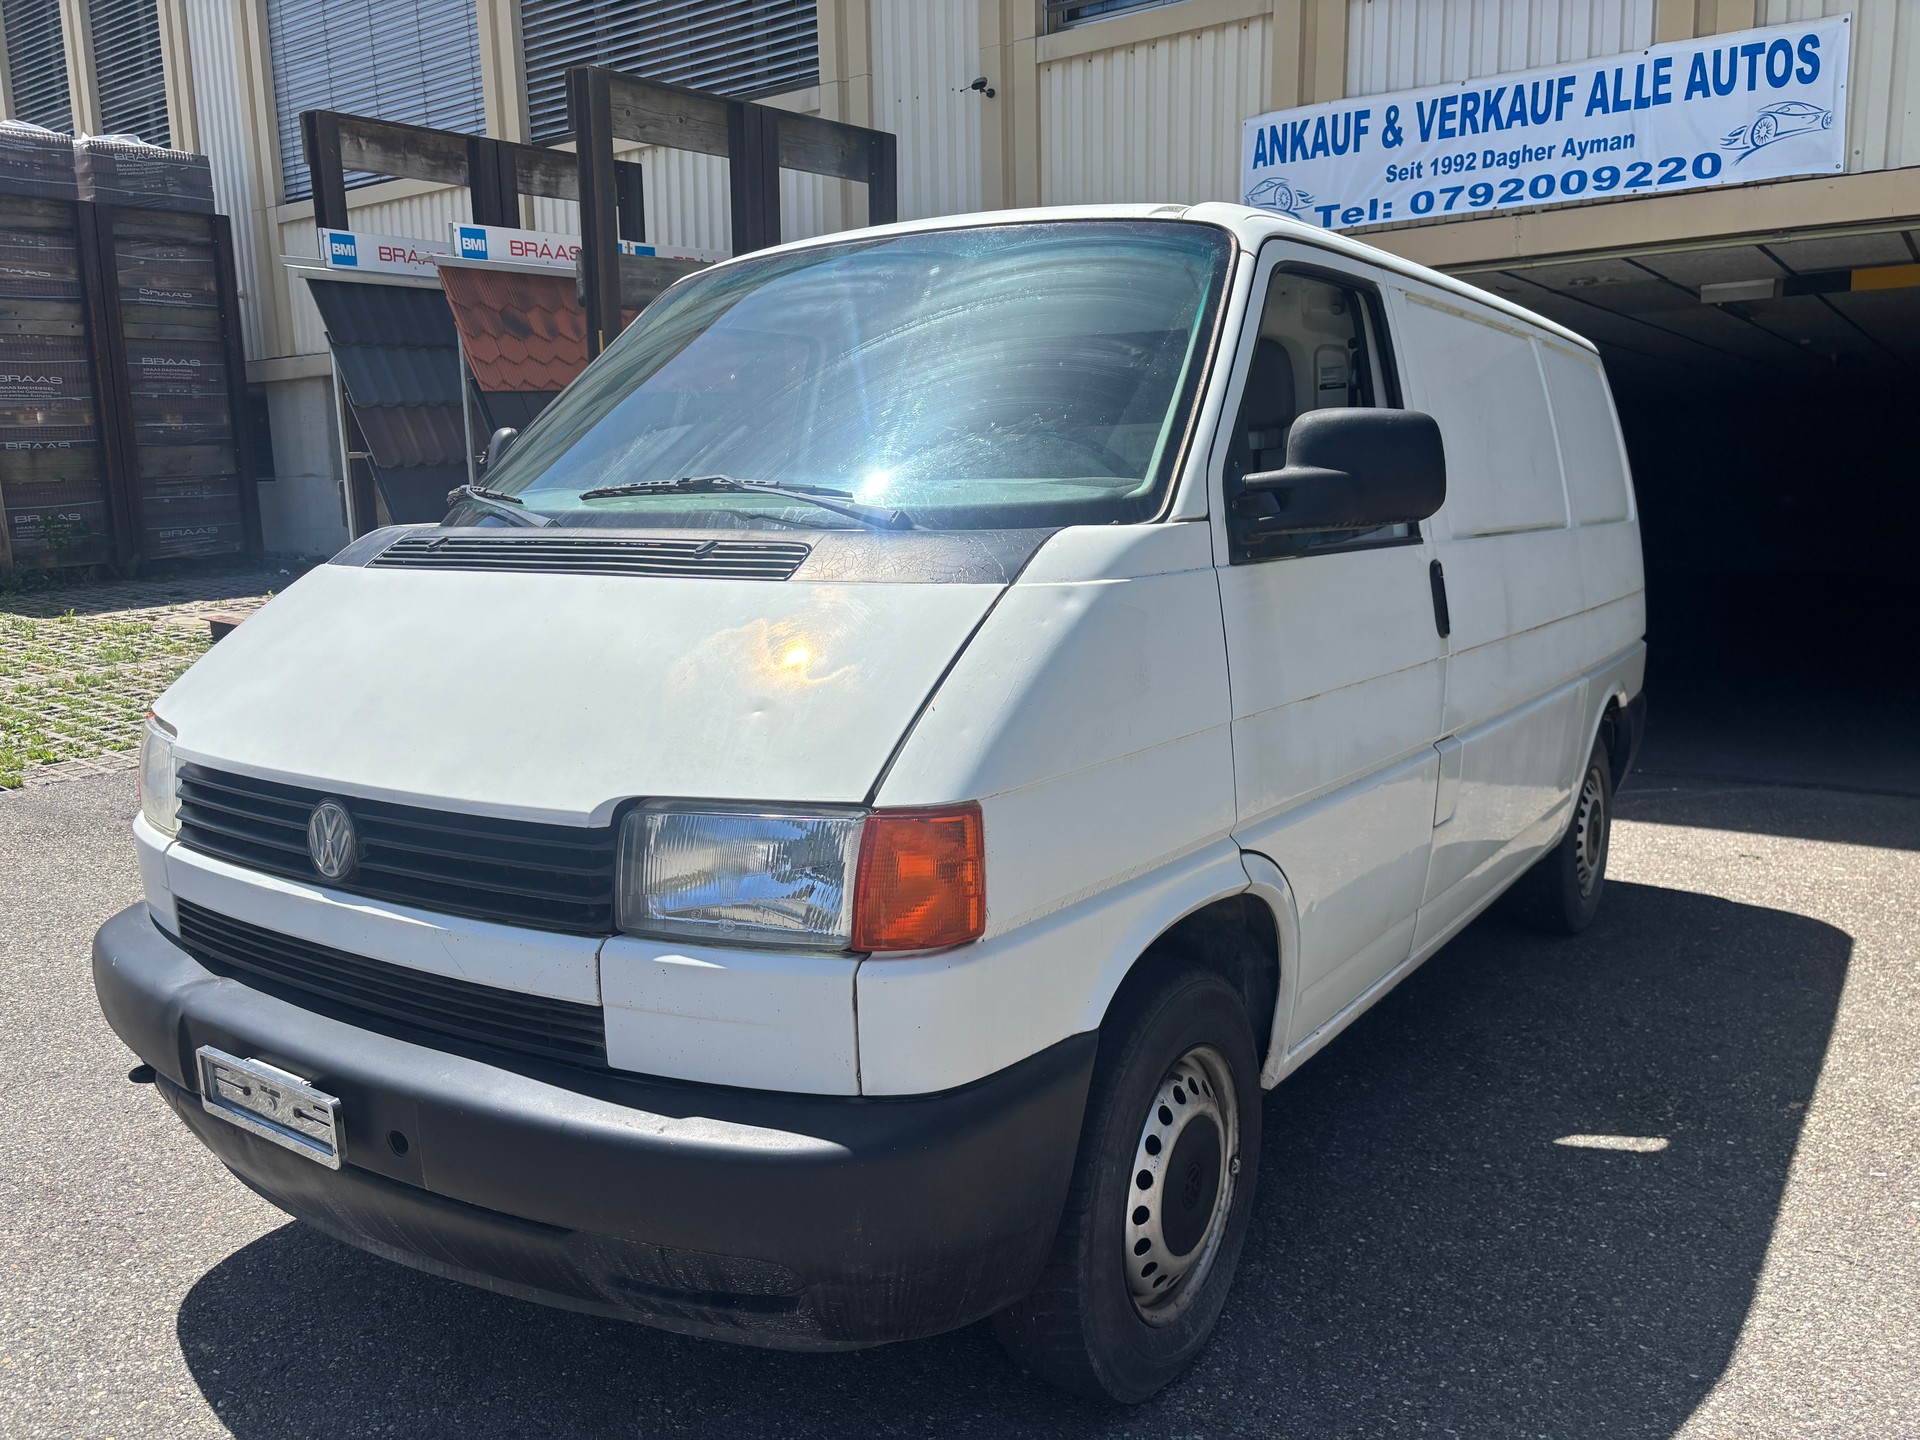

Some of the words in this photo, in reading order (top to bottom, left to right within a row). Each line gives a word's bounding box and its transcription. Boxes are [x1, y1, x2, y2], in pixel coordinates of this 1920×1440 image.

[1252, 109, 1371, 170] ANKAUF
[1381, 104, 1404, 149] &
[1416, 75, 1576, 143] VERKAUF
[1585, 57, 1673, 117] ALLE
[1684, 33, 1821, 101] AUTOS
[1385, 161, 1423, 183] Seit
[1430, 152, 1477, 176] 1992
[1482, 144, 1556, 170] Dagher
[1561, 133, 1635, 161] Ayman
[1314, 198, 1392, 229] Tel:
[1410, 152, 1722, 215] 0792009220
[331, 242, 356, 257] BMI
[461, 238, 486, 252] BMI
[510, 240, 582, 262] BRAAS
[142, 357, 201, 366] BRAAS
[15, 513, 81, 523] BRAS
[160, 527, 218, 538] BRAAS
